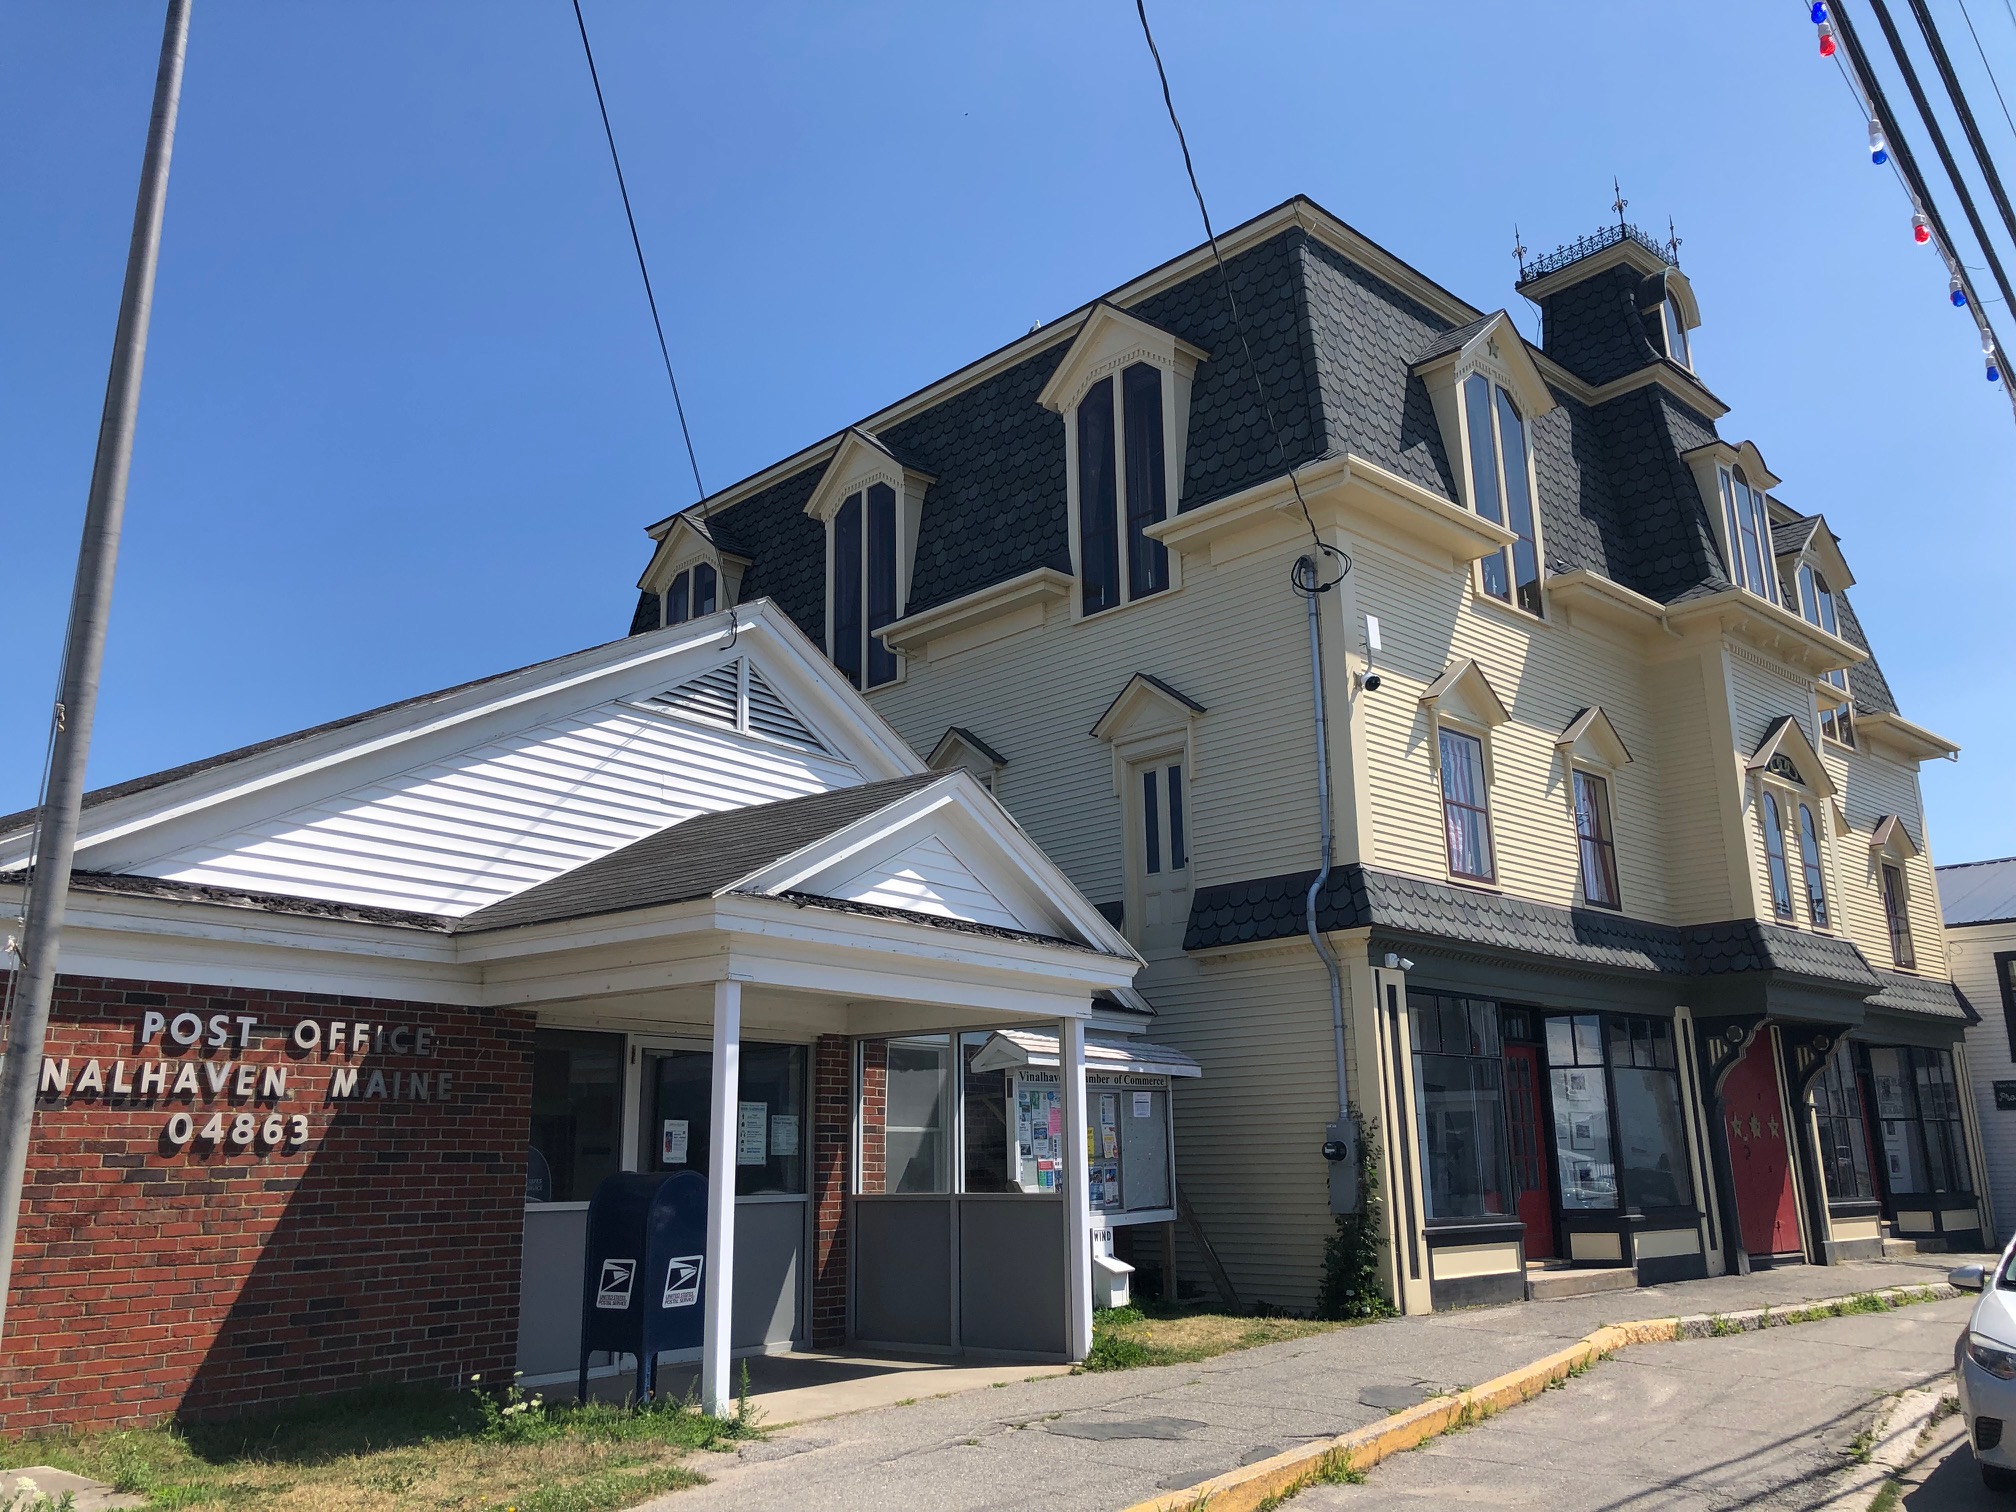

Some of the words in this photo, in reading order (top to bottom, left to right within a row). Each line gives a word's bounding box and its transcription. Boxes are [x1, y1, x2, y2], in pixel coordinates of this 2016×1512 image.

[142, 1011, 258, 1047] POST
[294, 1019, 433, 1056] OFFICE
[40, 1057, 288, 1098] NALHAVEN
[332, 1068, 454, 1101] MAINE
[1019, 1071, 1061, 1082] Vinalhav
[1113, 1074, 1123, 1084] of
[1123, 1075, 1164, 1086] Commerce
[168, 1113, 310, 1146] 04863
[1094, 1230, 1111, 1242] WIND
